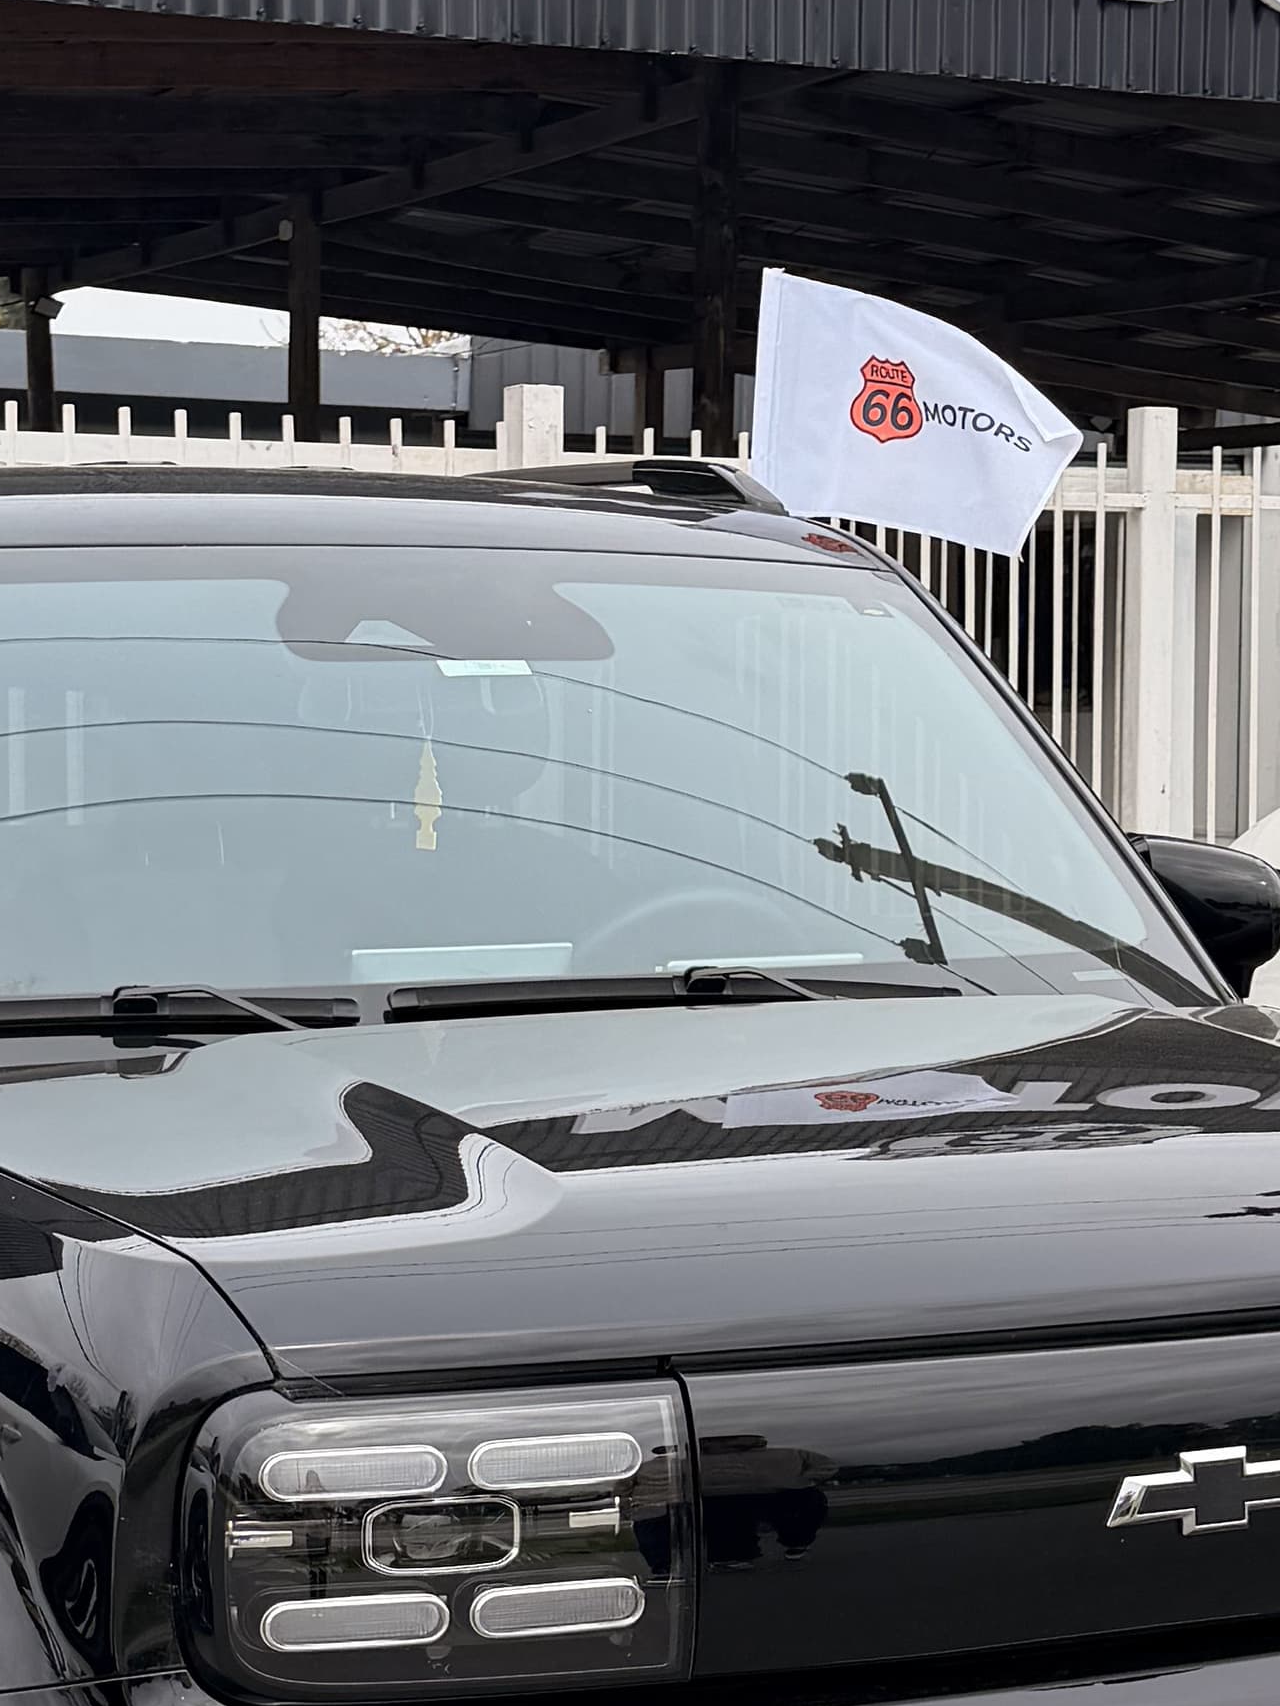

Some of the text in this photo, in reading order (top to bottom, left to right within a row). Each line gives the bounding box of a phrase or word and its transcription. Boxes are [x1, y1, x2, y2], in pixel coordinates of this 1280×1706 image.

[870, 364, 908, 383] ROUTE
[863, 389, 913, 431] 66
[922, 400, 1033, 452] MOTORS
